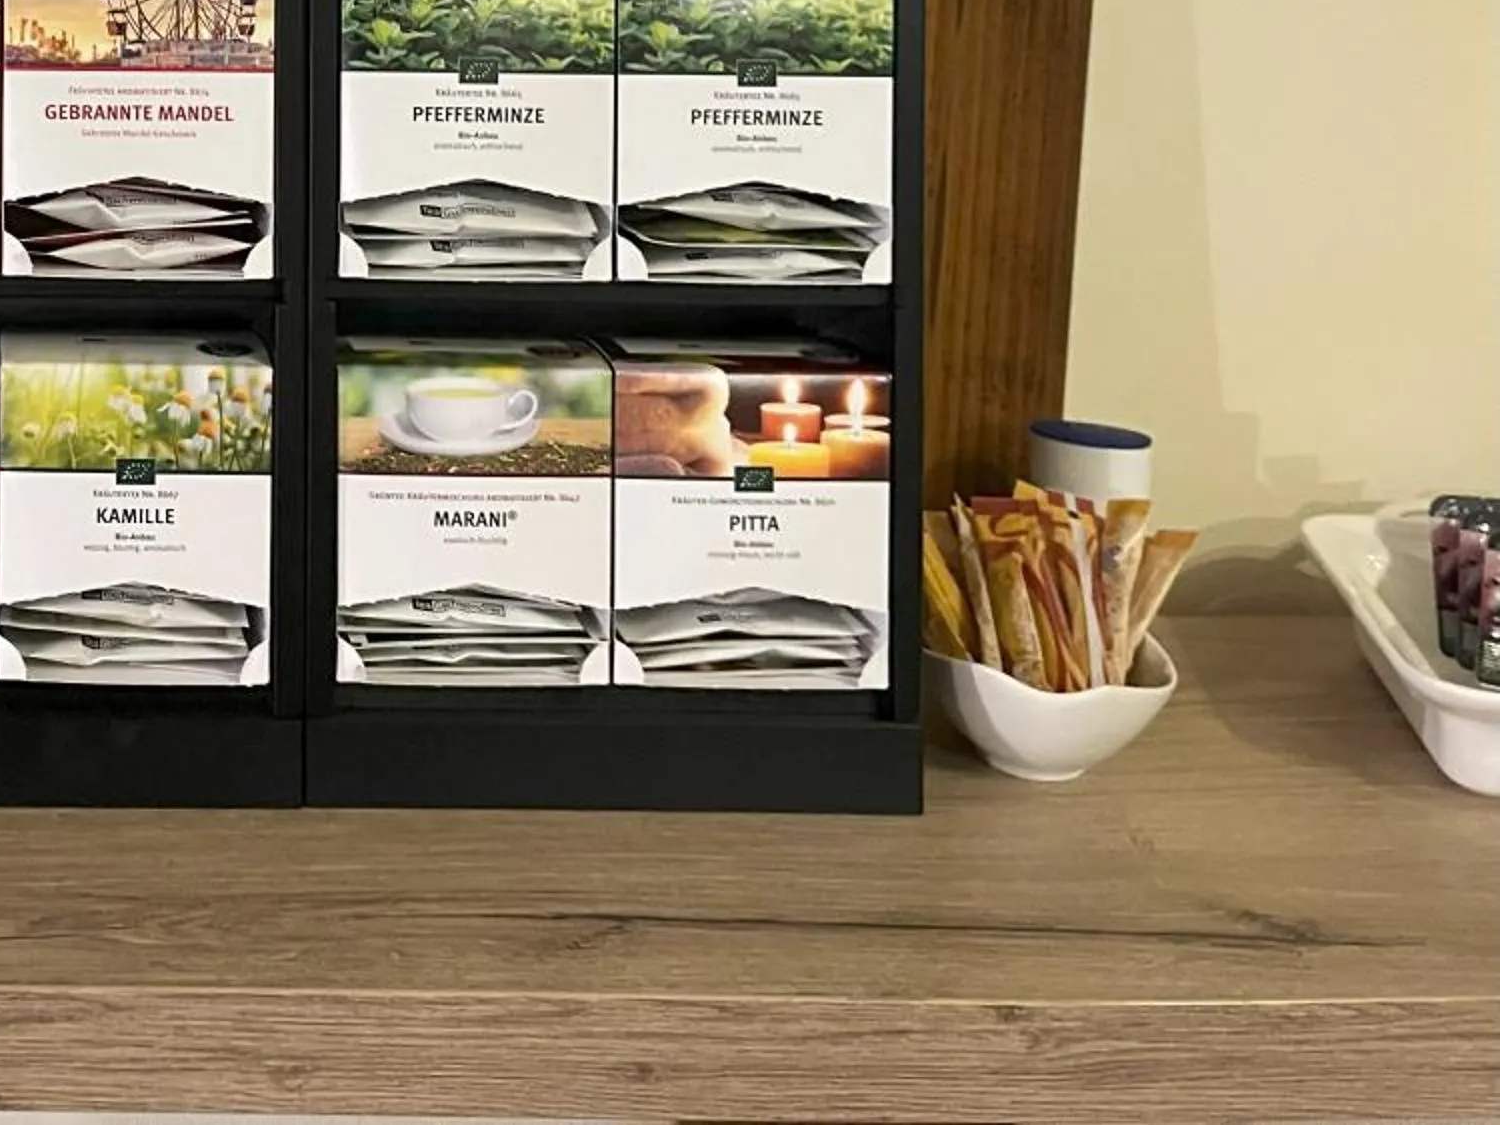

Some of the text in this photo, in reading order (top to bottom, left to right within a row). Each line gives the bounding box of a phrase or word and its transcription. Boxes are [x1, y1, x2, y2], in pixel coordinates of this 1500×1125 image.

[45, 104, 234, 121] GEBRANNTE MANDEL
[413, 106, 545, 123] PFEFFERMINZE
[691, 109, 823, 126] PFEFFERMINZE
[97, 508, 176, 524] KAMILLE
[729, 515, 780, 531] PITTA
